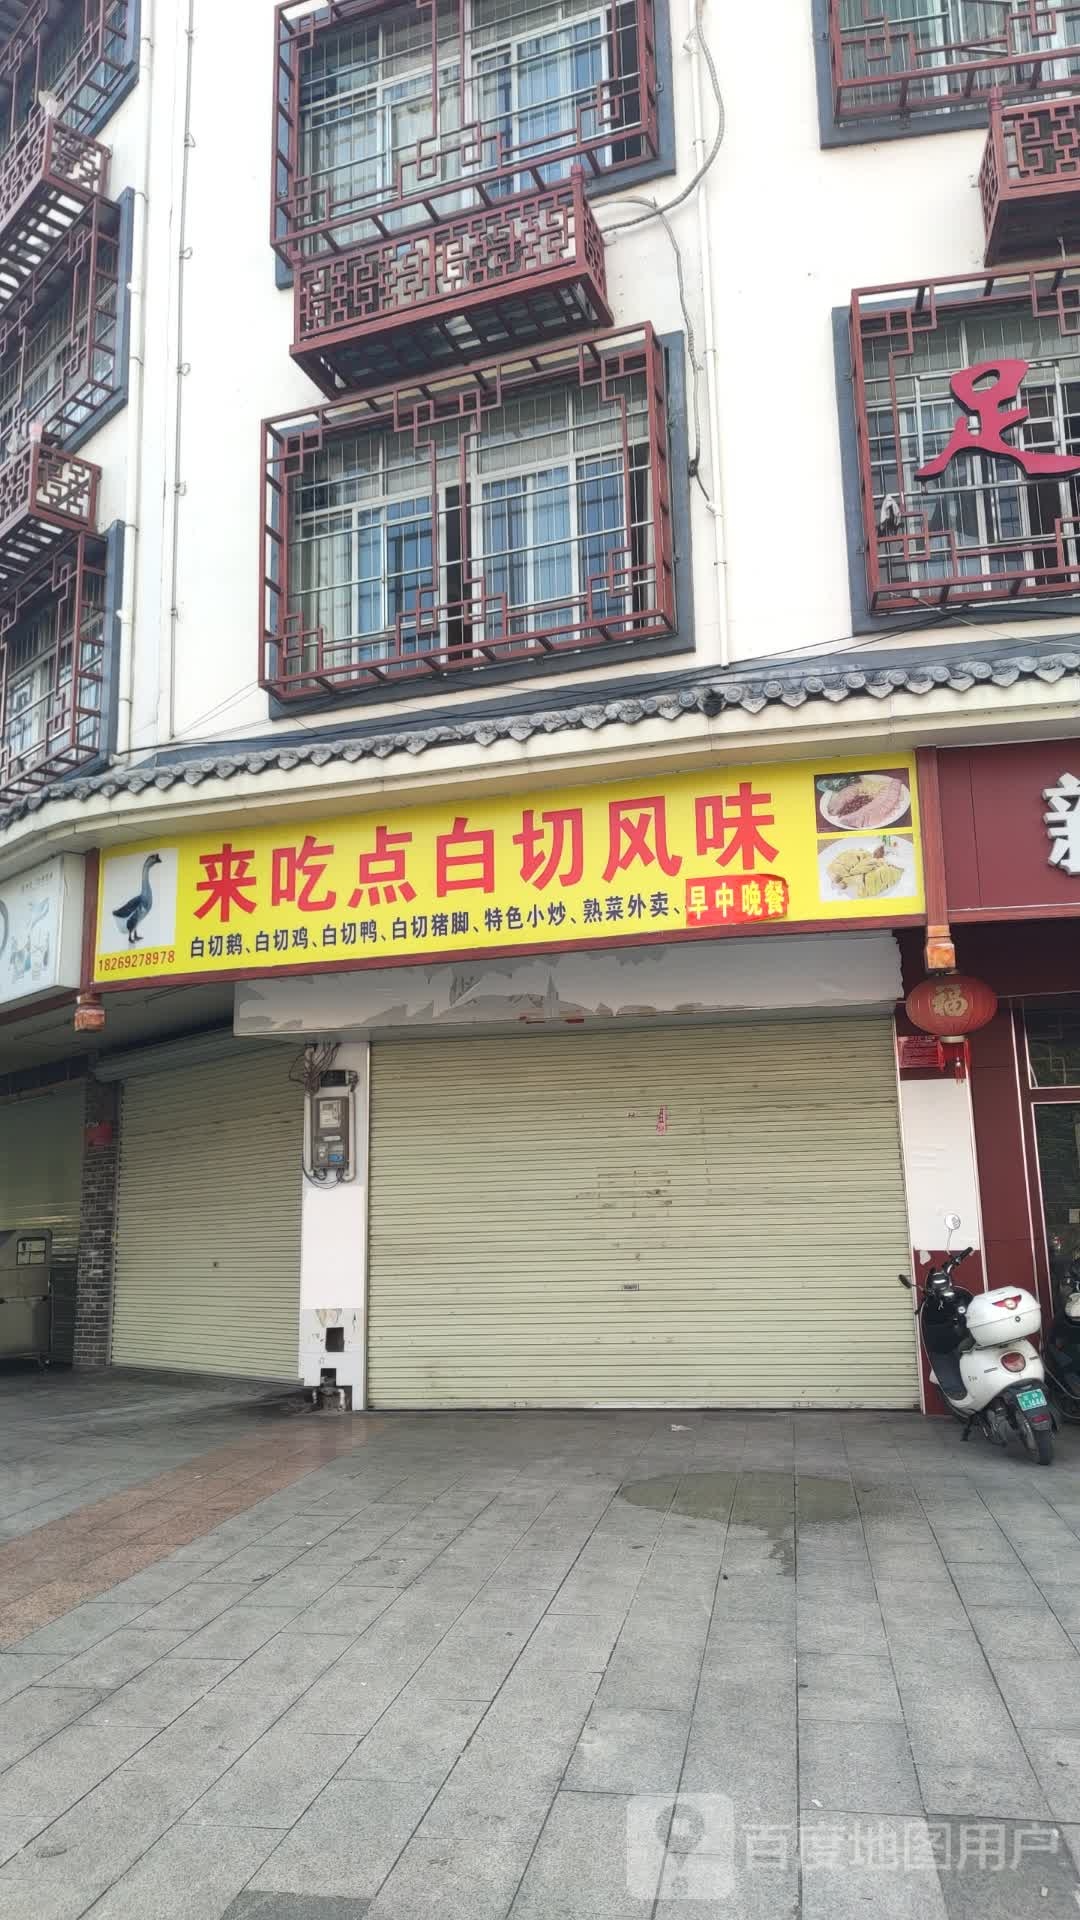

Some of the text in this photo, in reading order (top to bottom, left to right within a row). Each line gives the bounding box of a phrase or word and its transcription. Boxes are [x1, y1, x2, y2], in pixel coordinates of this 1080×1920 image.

[914, 359, 1080, 480] 足
[193, 781, 779, 923] 来吃点白切风味
[688, 880, 785, 920] 早中晚餐
[98, 950, 176, 972] 18269278978
